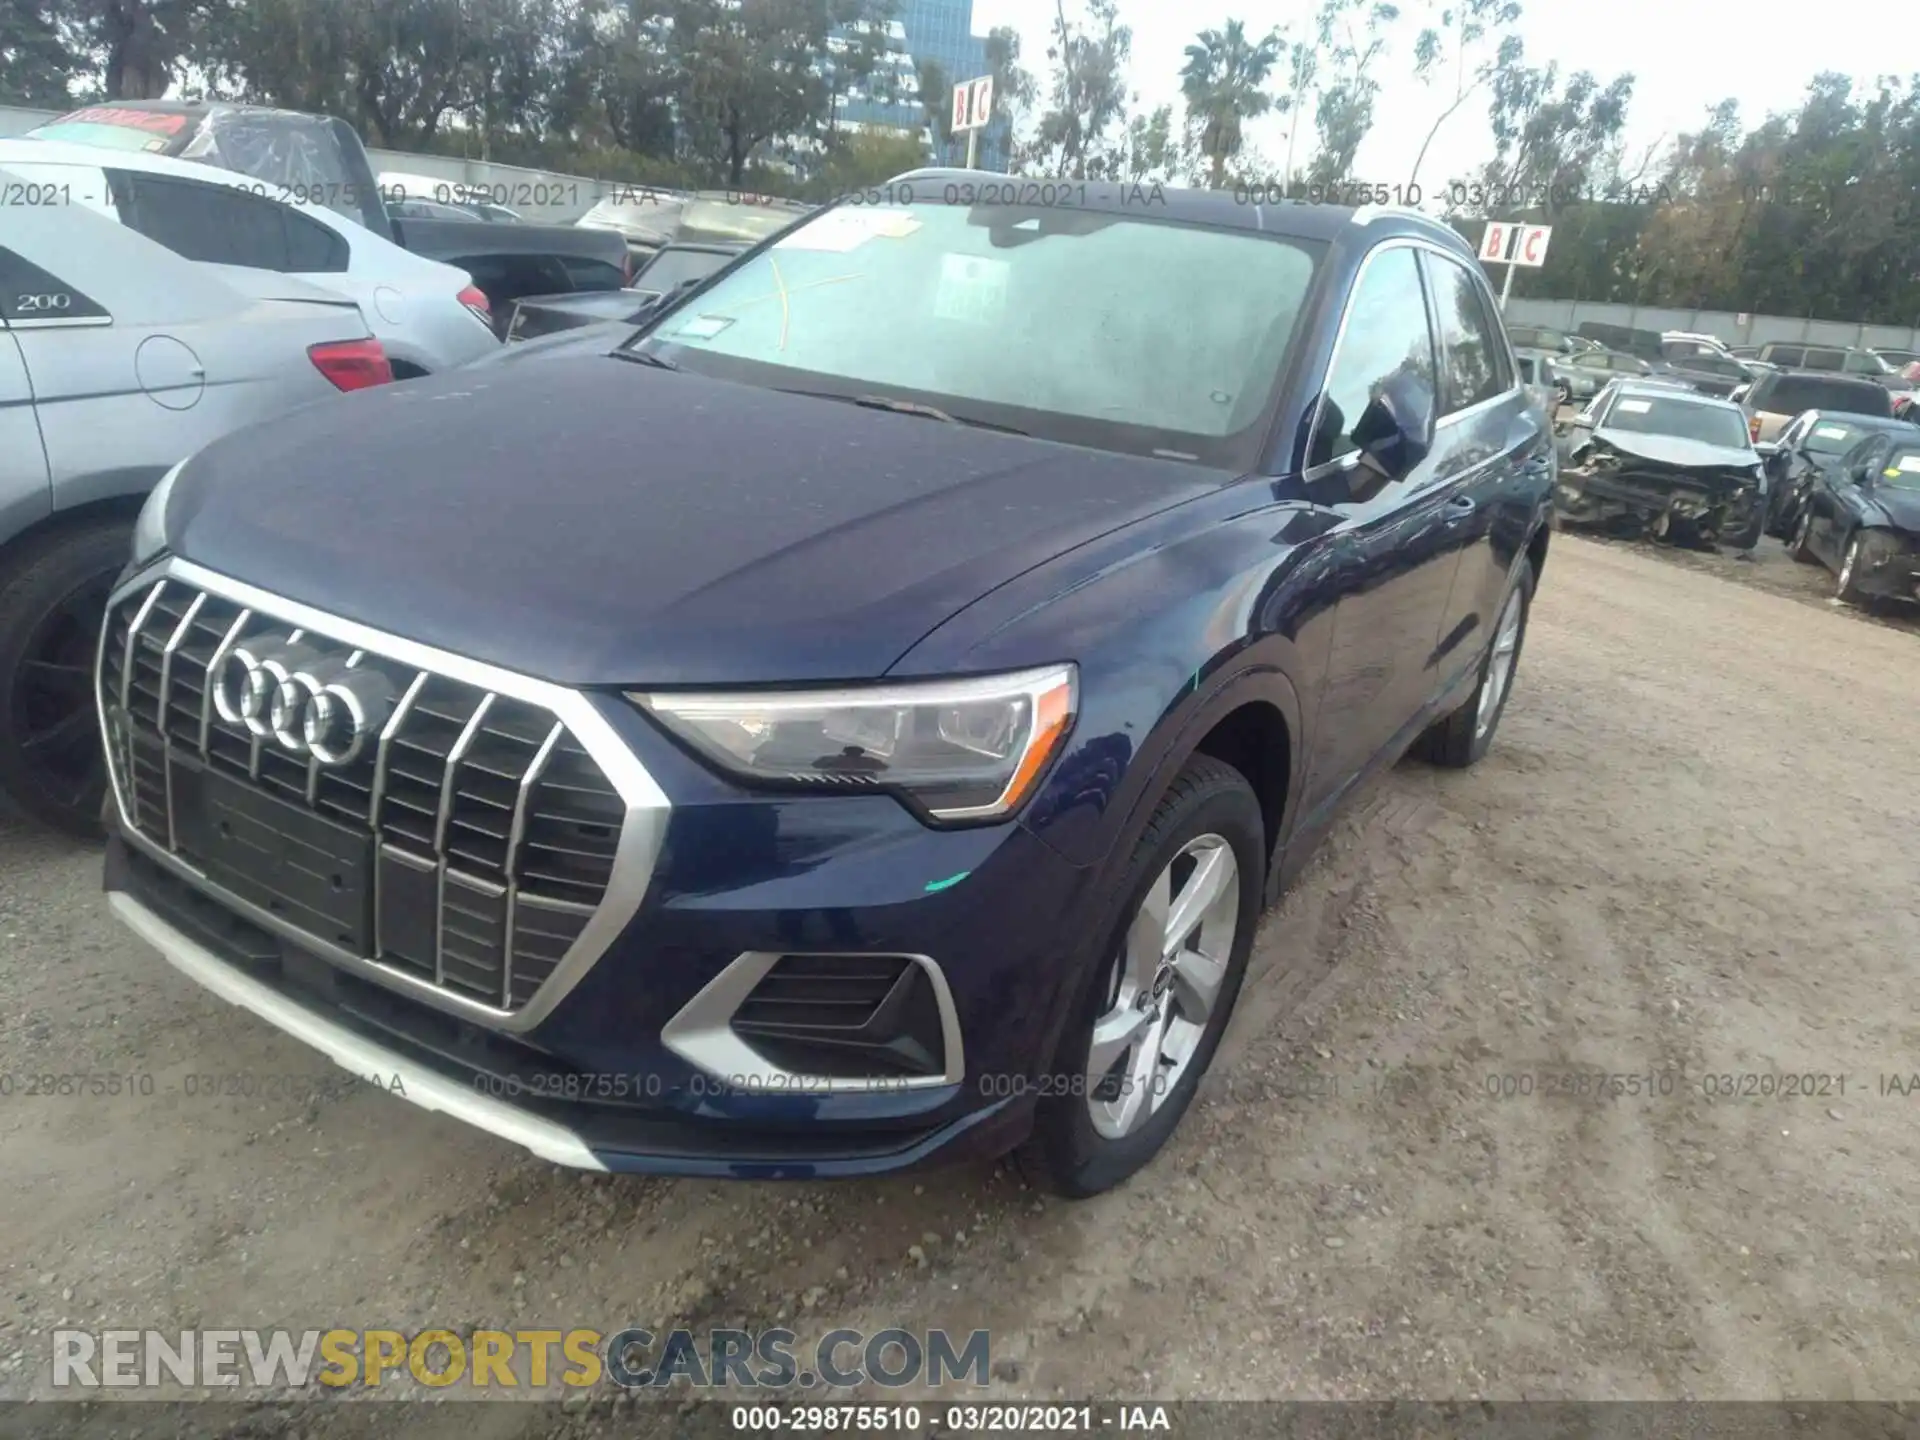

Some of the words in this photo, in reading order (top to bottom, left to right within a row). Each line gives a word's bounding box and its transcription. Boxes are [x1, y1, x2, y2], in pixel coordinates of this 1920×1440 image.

[978, 82, 988, 121] C
[1486, 224, 1503, 257] B
[1525, 230, 1543, 262] C
[17, 293, 71, 311] 200
